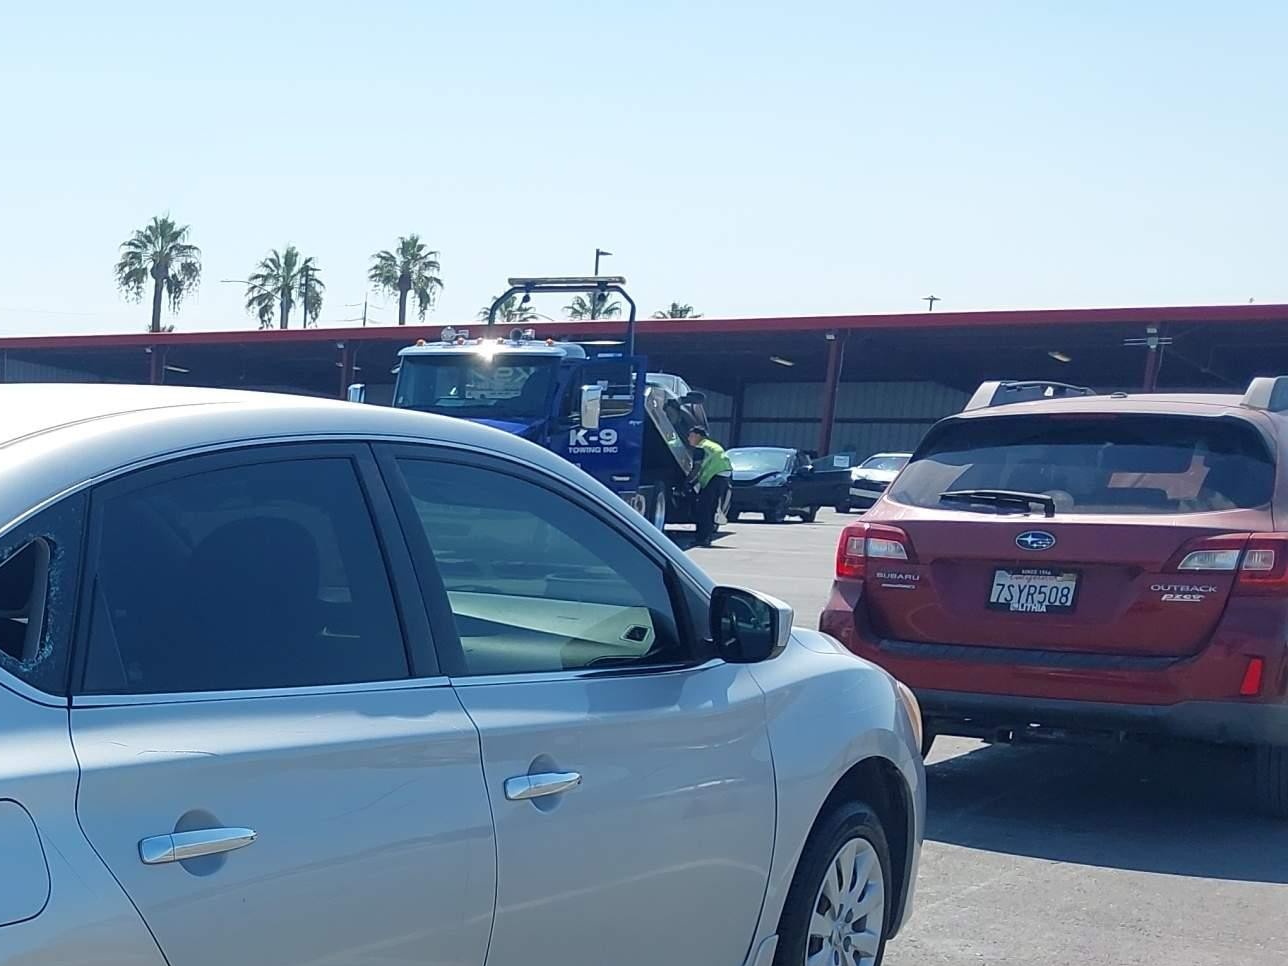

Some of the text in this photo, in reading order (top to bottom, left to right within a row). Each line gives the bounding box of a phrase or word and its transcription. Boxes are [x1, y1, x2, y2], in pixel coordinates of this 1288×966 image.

[569, 428, 618, 446] K-9
[876, 572, 920, 581] SUBARU
[995, 583, 1071, 605] 7SYR508
[1150, 584, 1217, 592] OUTBACK
